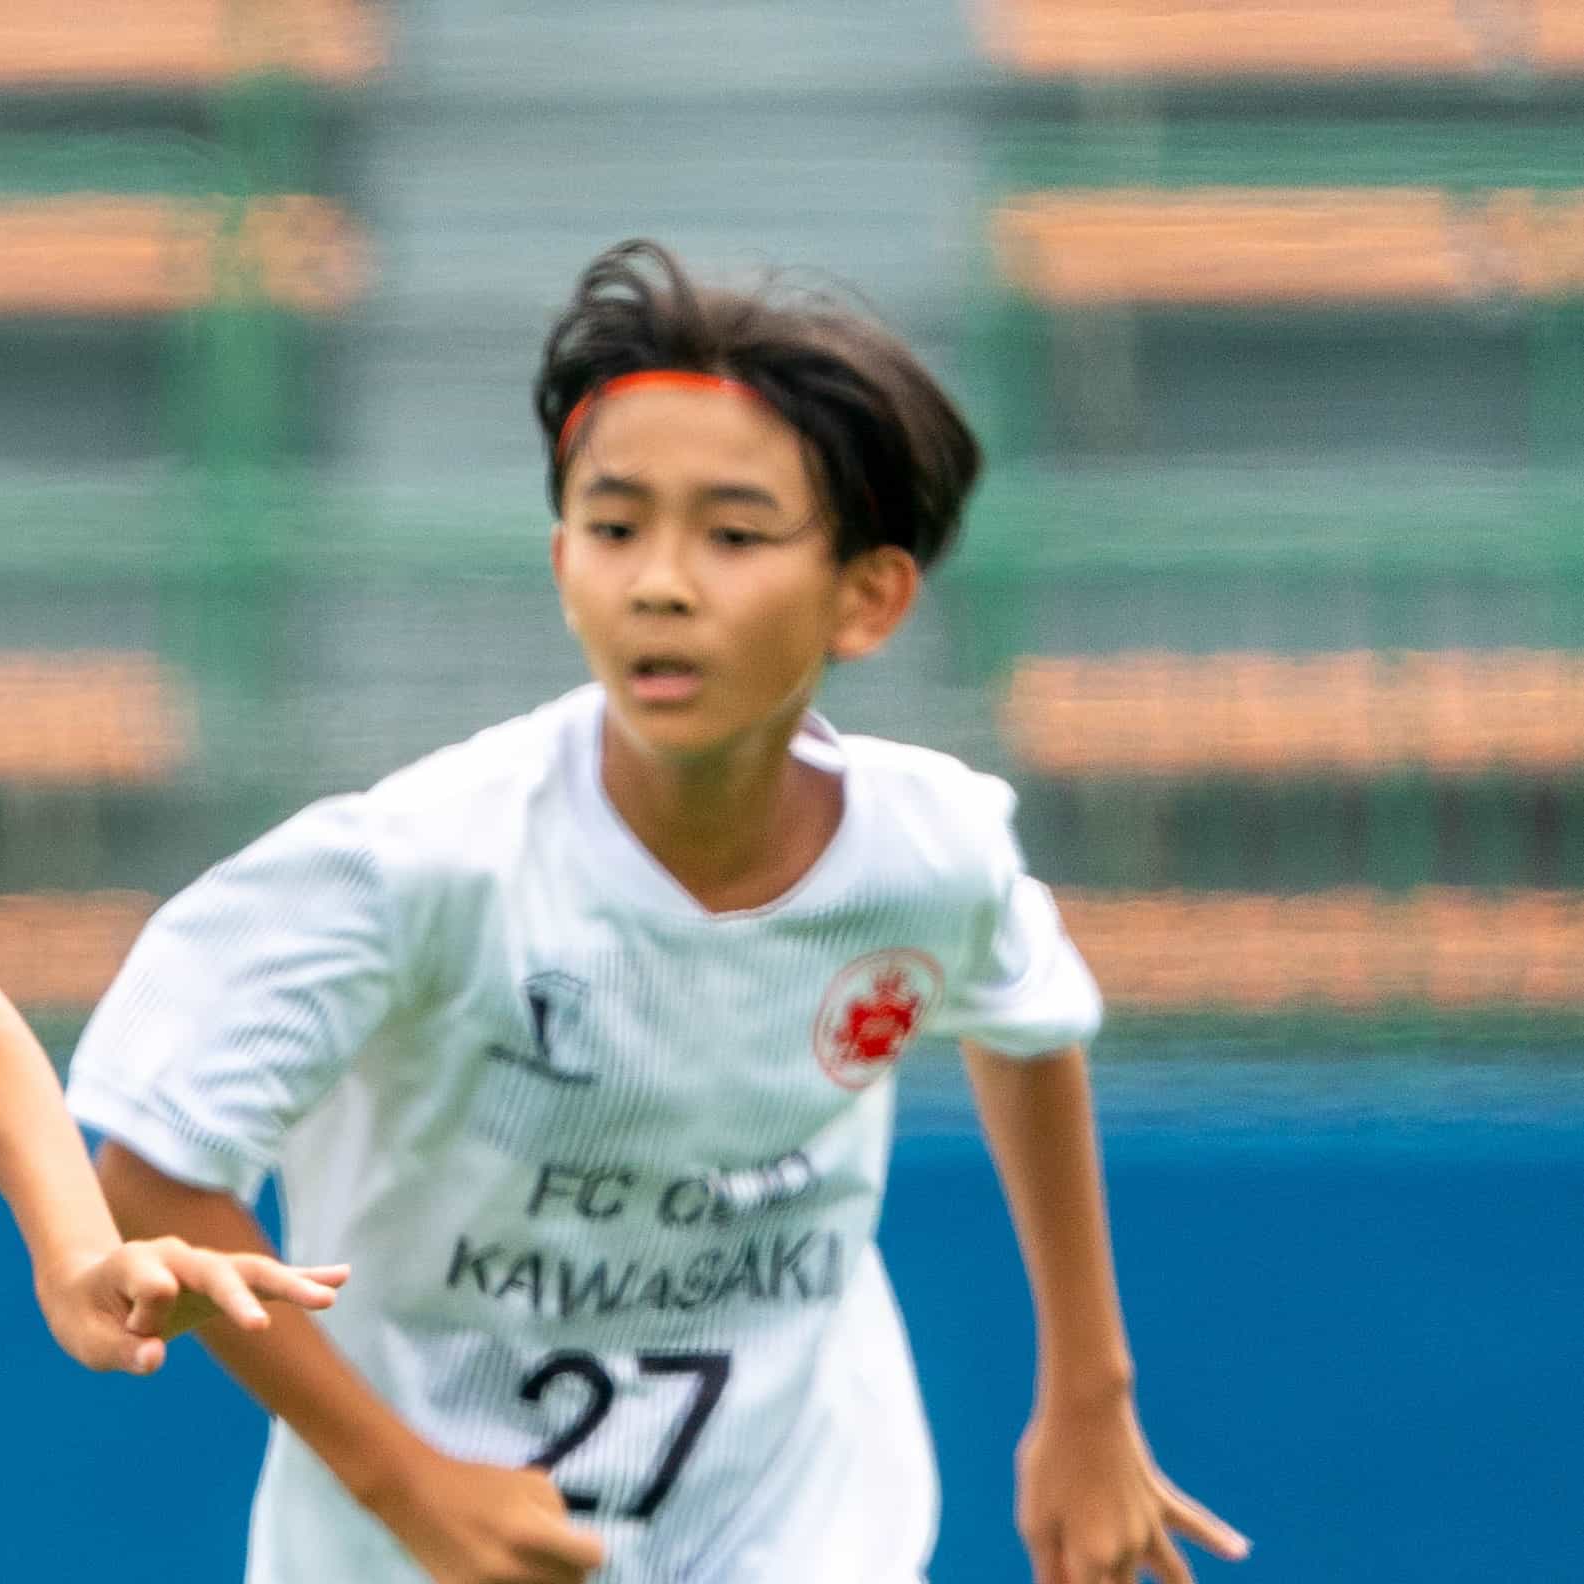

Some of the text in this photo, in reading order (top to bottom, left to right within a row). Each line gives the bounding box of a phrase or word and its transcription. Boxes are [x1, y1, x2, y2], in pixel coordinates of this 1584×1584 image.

[527, 1160, 635, 1222] FC
[445, 1232, 845, 1320] KAWASAKI
[517, 1348, 731, 1522] 27
